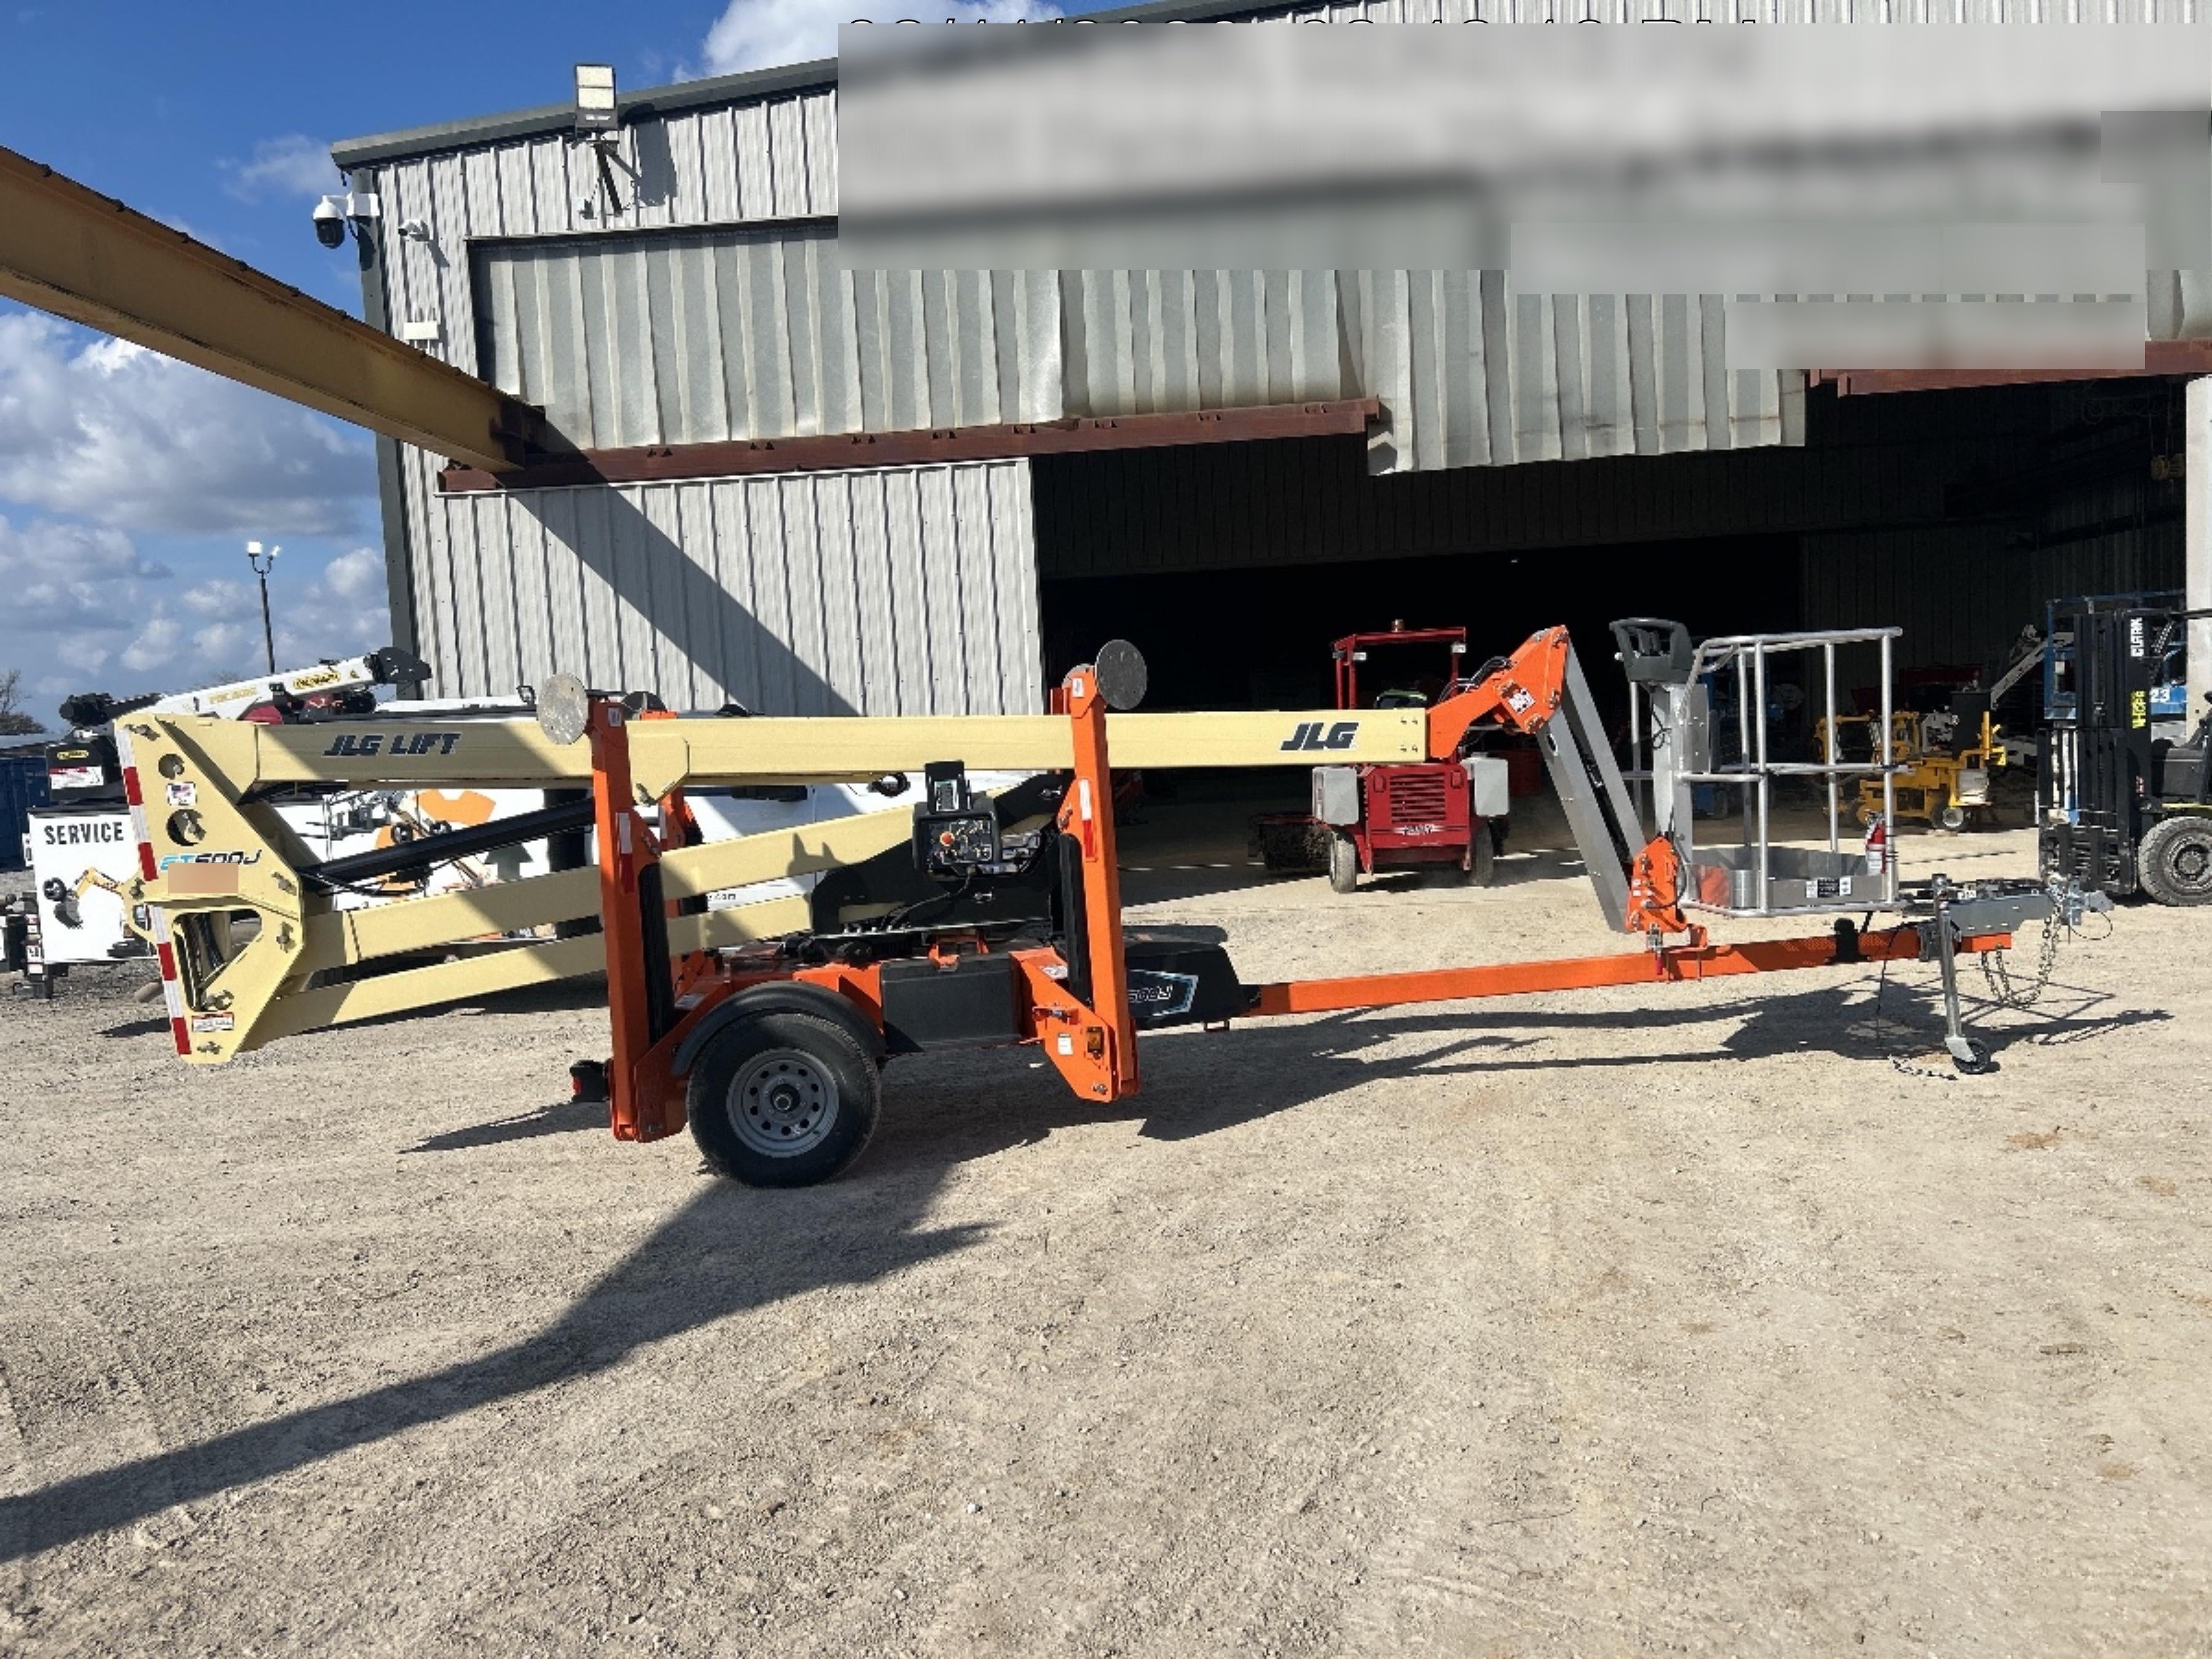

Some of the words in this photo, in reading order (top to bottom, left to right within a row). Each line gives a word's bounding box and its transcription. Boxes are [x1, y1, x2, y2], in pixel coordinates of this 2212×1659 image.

[2130, 617, 2144, 657] CLARK
[322, 734, 385, 756] JLG
[388, 733, 461, 755] LIFT
[1280, 722, 1359, 751] JLG
[44, 822, 124, 845] SERVICE
